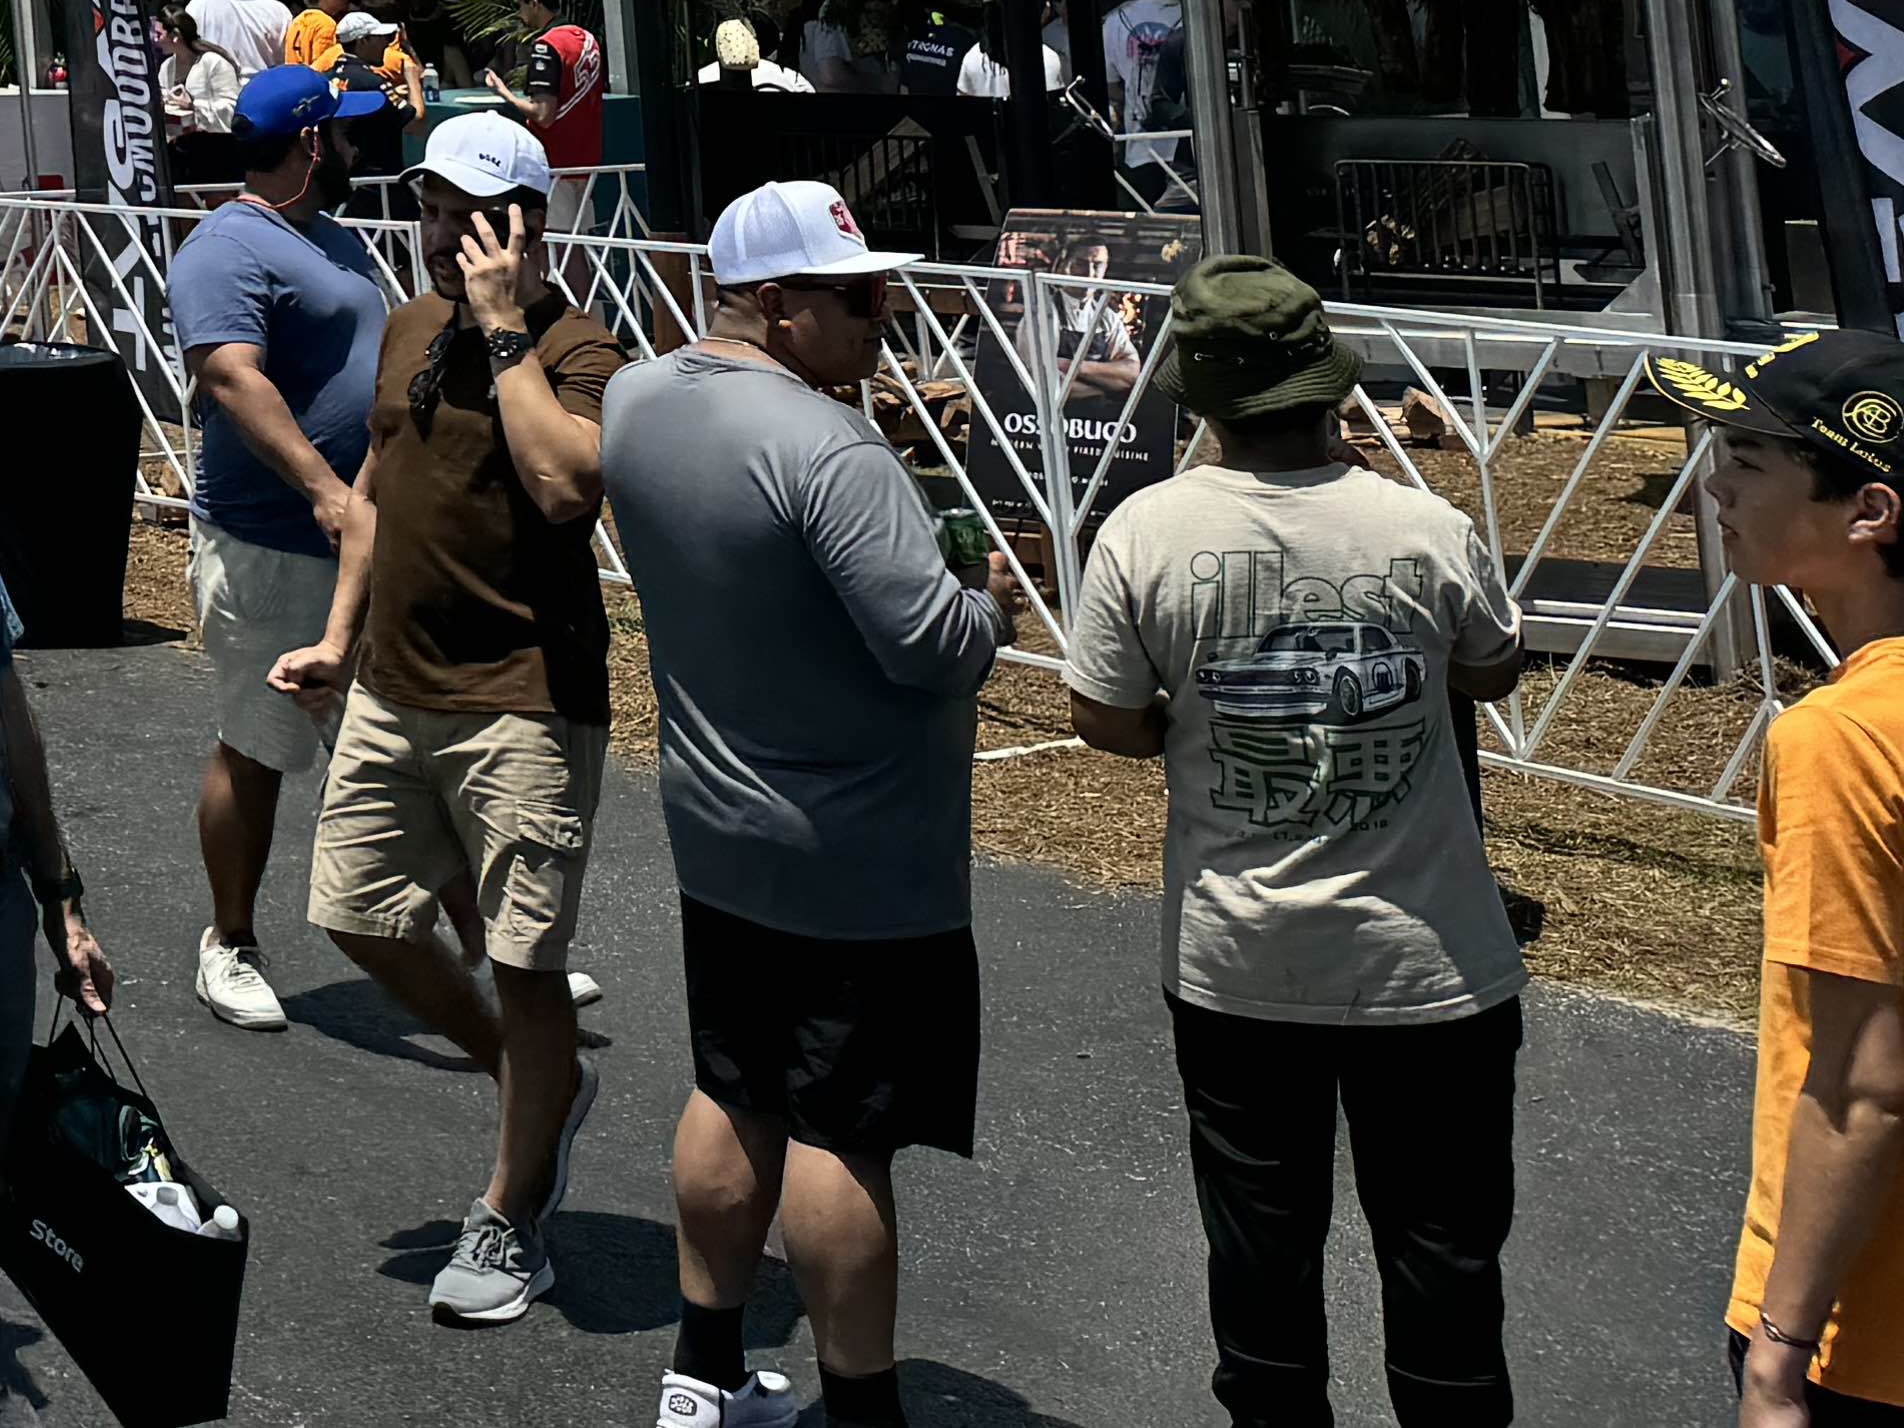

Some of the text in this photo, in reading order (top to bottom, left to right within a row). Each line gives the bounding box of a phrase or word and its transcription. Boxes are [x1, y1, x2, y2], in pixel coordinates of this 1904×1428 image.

[1003, 412, 1137, 444] OSBUCO
[1112, 450, 1149, 462] UISINE
[1189, 549, 1423, 640] illest
[29, 1219, 84, 1273] Store
